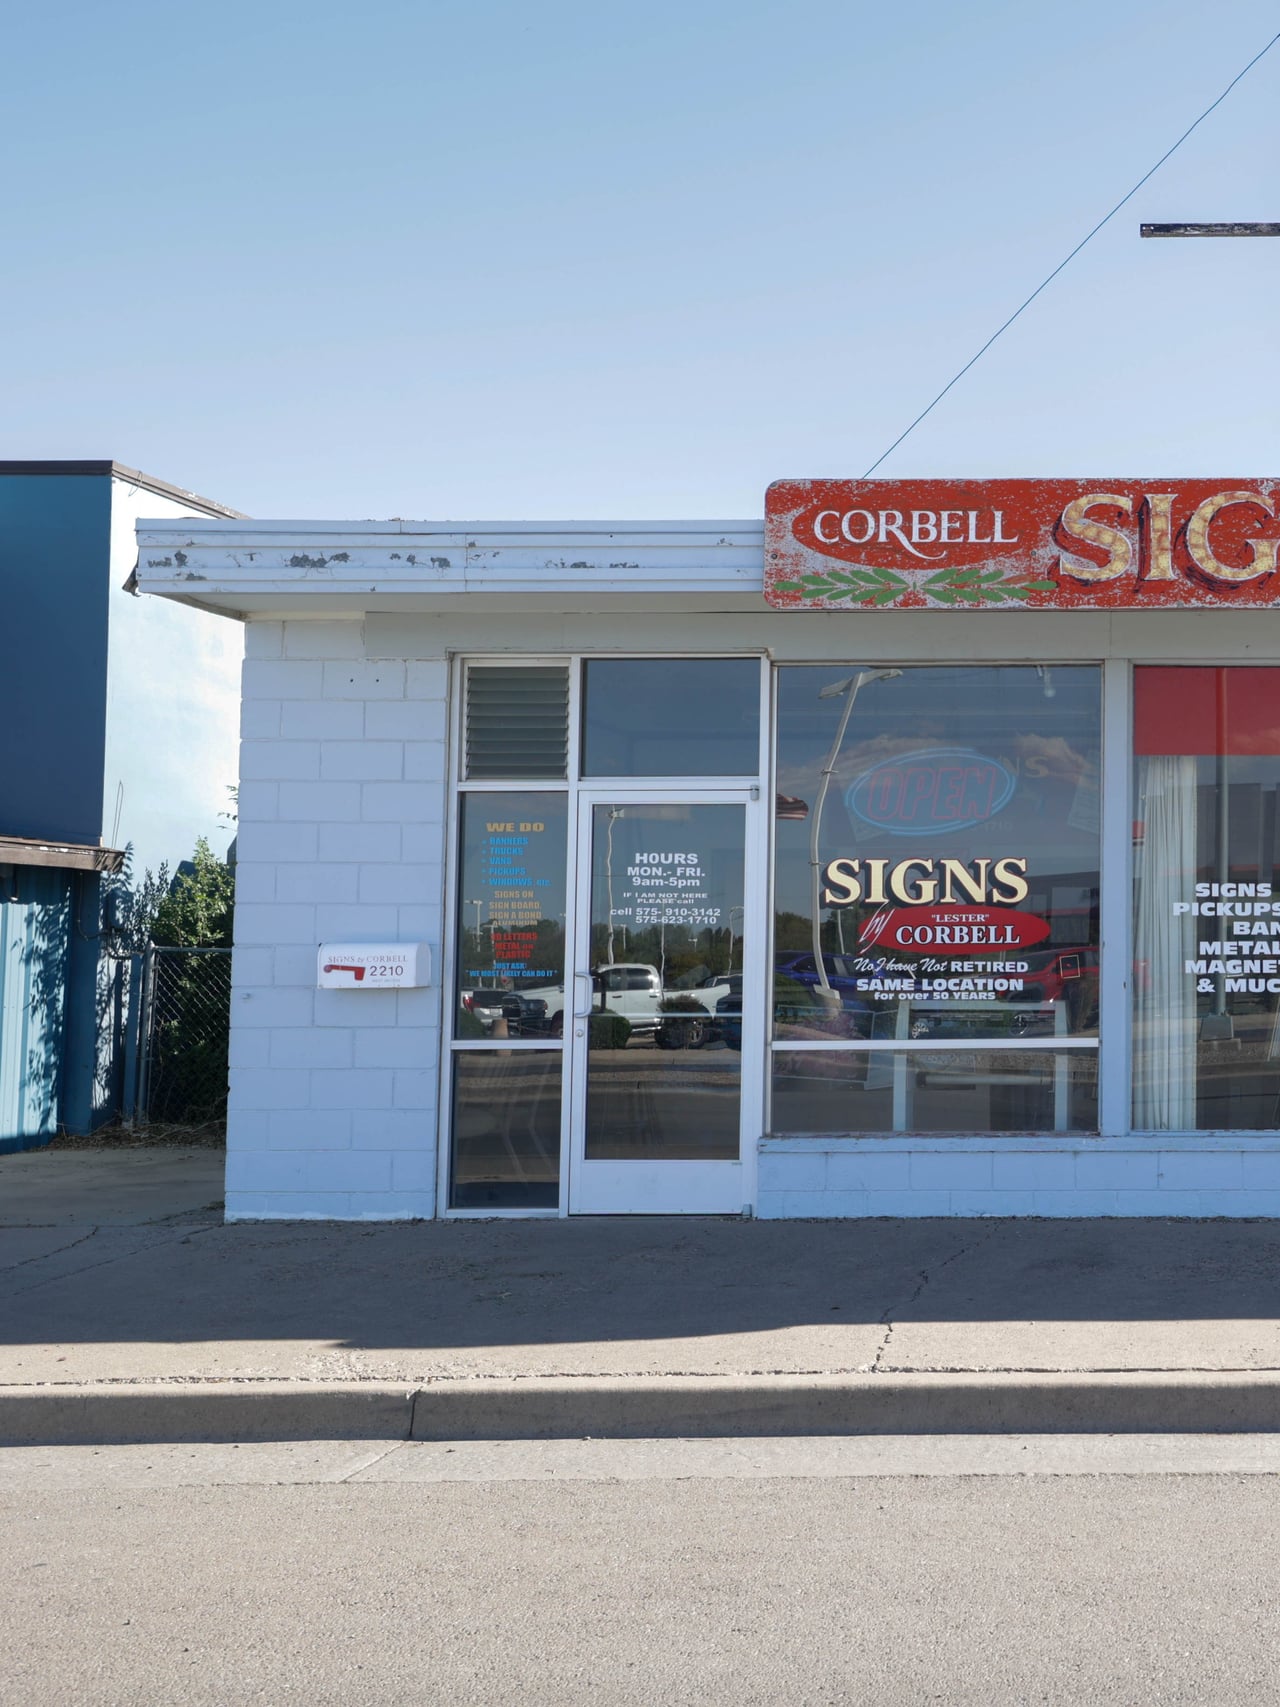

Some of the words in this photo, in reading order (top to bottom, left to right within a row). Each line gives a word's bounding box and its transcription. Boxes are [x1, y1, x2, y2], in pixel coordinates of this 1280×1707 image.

[813, 509, 1019, 559] CORBELL
[867, 767, 997, 821] OPEN
[486, 823, 515, 833] WE
[519, 823, 545, 833] DO
[635, 852, 699, 865] HOURS
[676, 866, 706, 878] FRI.
[632, 876, 701, 889] 9am-5pm
[823, 857, 1029, 906] SIGNS
[495, 890, 520, 899] SIGNS
[522, 890, 534, 898] ON
[1195, 883, 1272, 898] SIGNS
[489, 901, 509, 910] SIGN
[610, 907, 632, 916] cell
[489, 911, 509, 920] SIGN
[511, 911, 517, 919] A
[635, 915, 717, 925] 575-623-1710
[931, 913, 990, 923] "LESTER"
[858, 900, 896, 955] by
[895, 925, 1021, 945] CORBELL
[369, 965, 404, 976] 2210
[853, 957, 874, 973] No
[886, 958, 918, 972] have
[920, 957, 949, 973] Not
[951, 961, 1030, 973] RETIRED
[856, 978, 915, 991] SAME
[922, 978, 1024, 992] LOCATION
[1196, 978, 1216, 993] &
[874, 991, 895, 1000] for
[898, 992, 929, 1000] over
[932, 991, 950, 1000] 50
[952, 991, 997, 1000] YEARS
